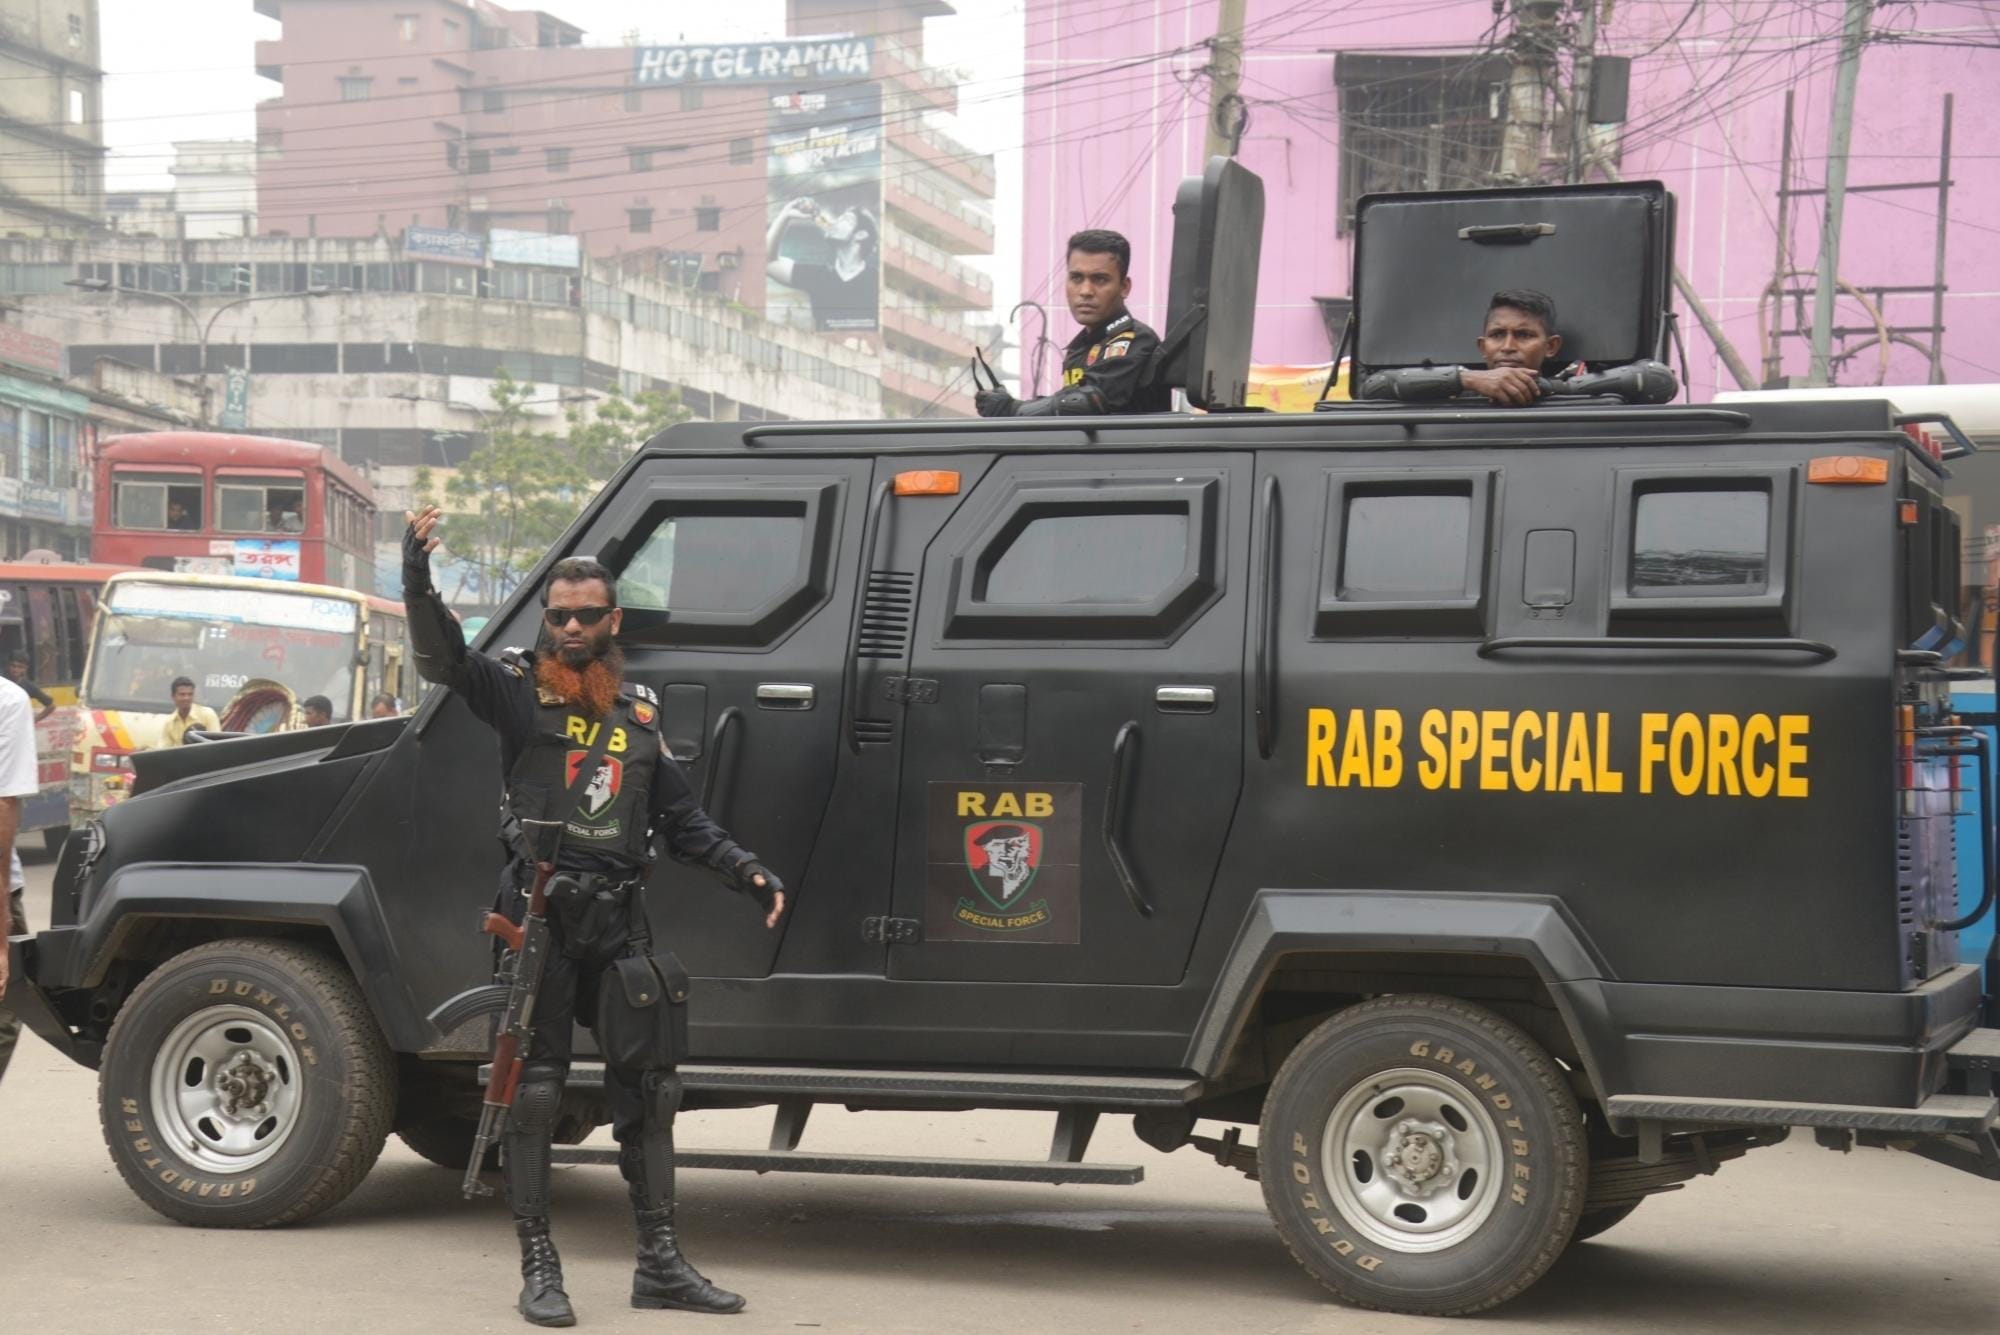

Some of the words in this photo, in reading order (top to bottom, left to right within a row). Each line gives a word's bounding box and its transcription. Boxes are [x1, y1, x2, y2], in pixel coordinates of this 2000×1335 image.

[638, 47, 753, 82] HOTEL
[758, 42, 871, 76] RAMNA
[1106, 315, 1130, 331] RAB
[1307, 708, 1403, 788] RAB
[1418, 708, 1623, 793] SPECIAL
[1640, 712, 1809, 797] FORCE
[593, 826, 619, 837] FORCE
[957, 792, 1054, 817] RAB
[959, 909, 1005, 928] SPECIAL
[1007, 910, 1046, 928] FORCE
[208, 978, 318, 1066] DUNLOP
[121, 1096, 257, 1199] GRANDTREK
[1408, 1039, 1531, 1208] GRANDTREK
[1291, 1132, 1384, 1273] DUNLOP
